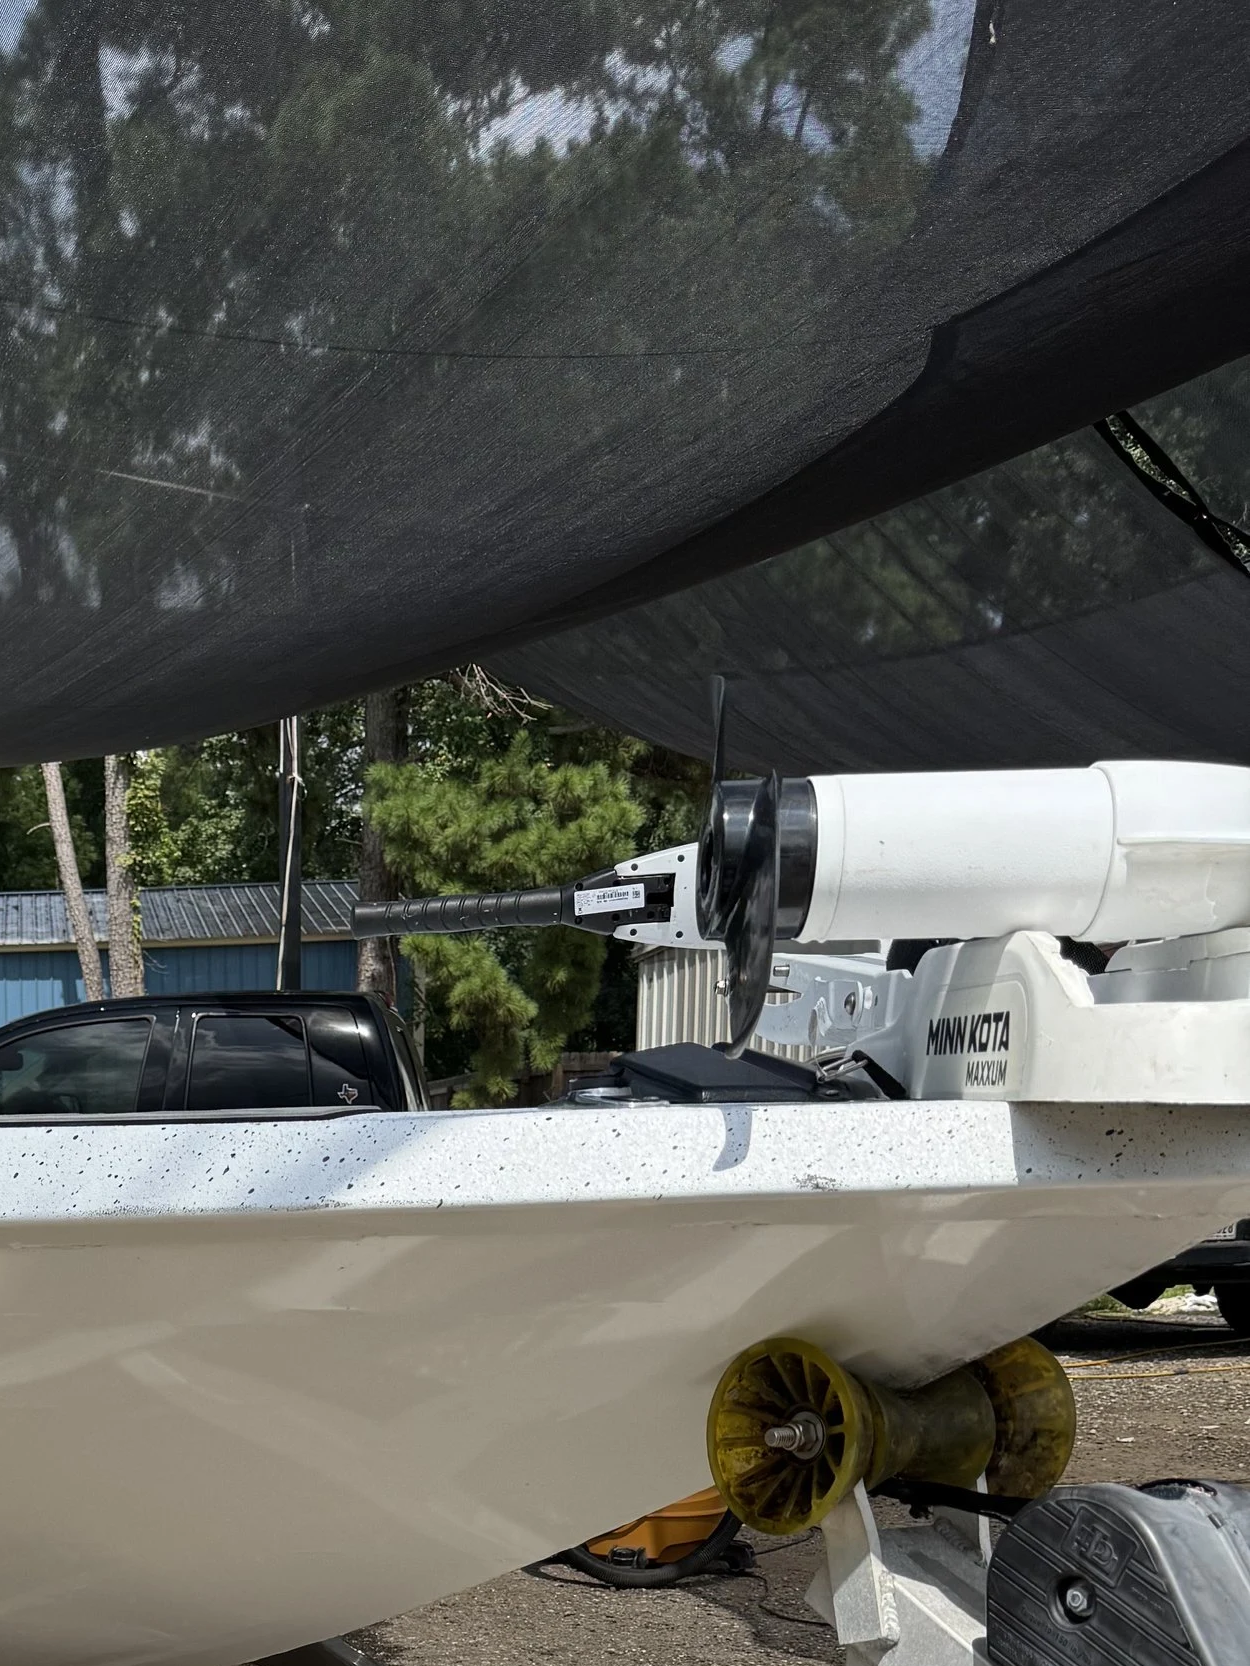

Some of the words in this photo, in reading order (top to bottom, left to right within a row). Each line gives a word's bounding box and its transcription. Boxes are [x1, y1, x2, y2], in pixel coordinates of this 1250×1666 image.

[926, 1015, 968, 1056] MINN
[967, 1010, 1010, 1054] KOTA
[965, 1059, 1008, 1087] MAXXUM
